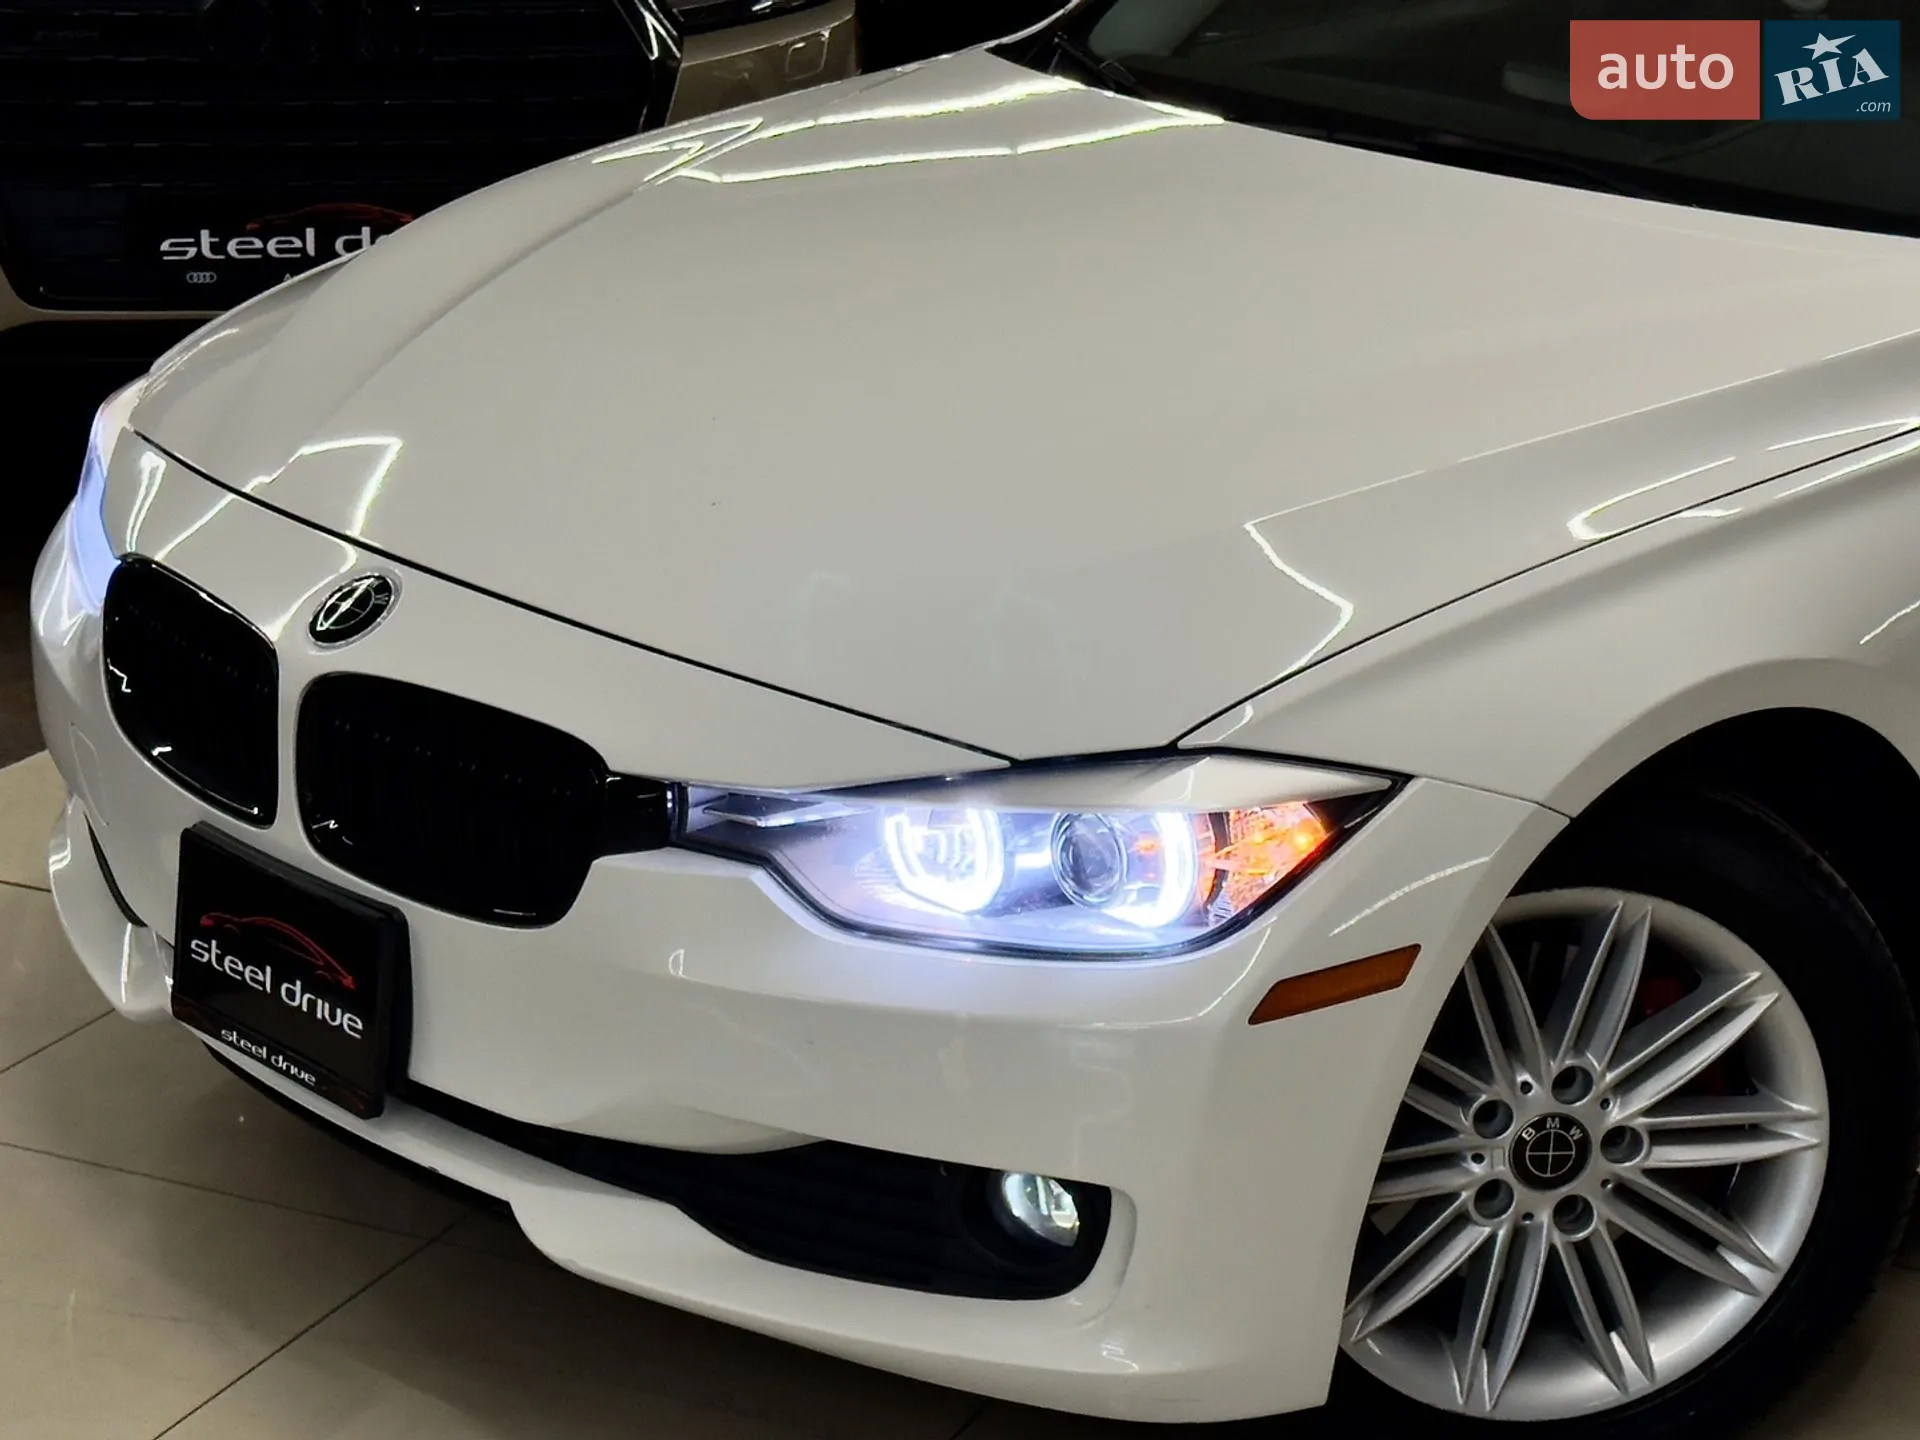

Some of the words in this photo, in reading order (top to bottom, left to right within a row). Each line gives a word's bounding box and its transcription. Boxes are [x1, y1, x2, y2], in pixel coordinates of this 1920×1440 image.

[160, 227, 316, 260] steel
[190, 938, 272, 994] steel
[280, 979, 364, 1040] drive
[220, 1028, 267, 1061] steel
[270, 1053, 317, 1086] drive
[1521, 1117, 1584, 1141] BMW
